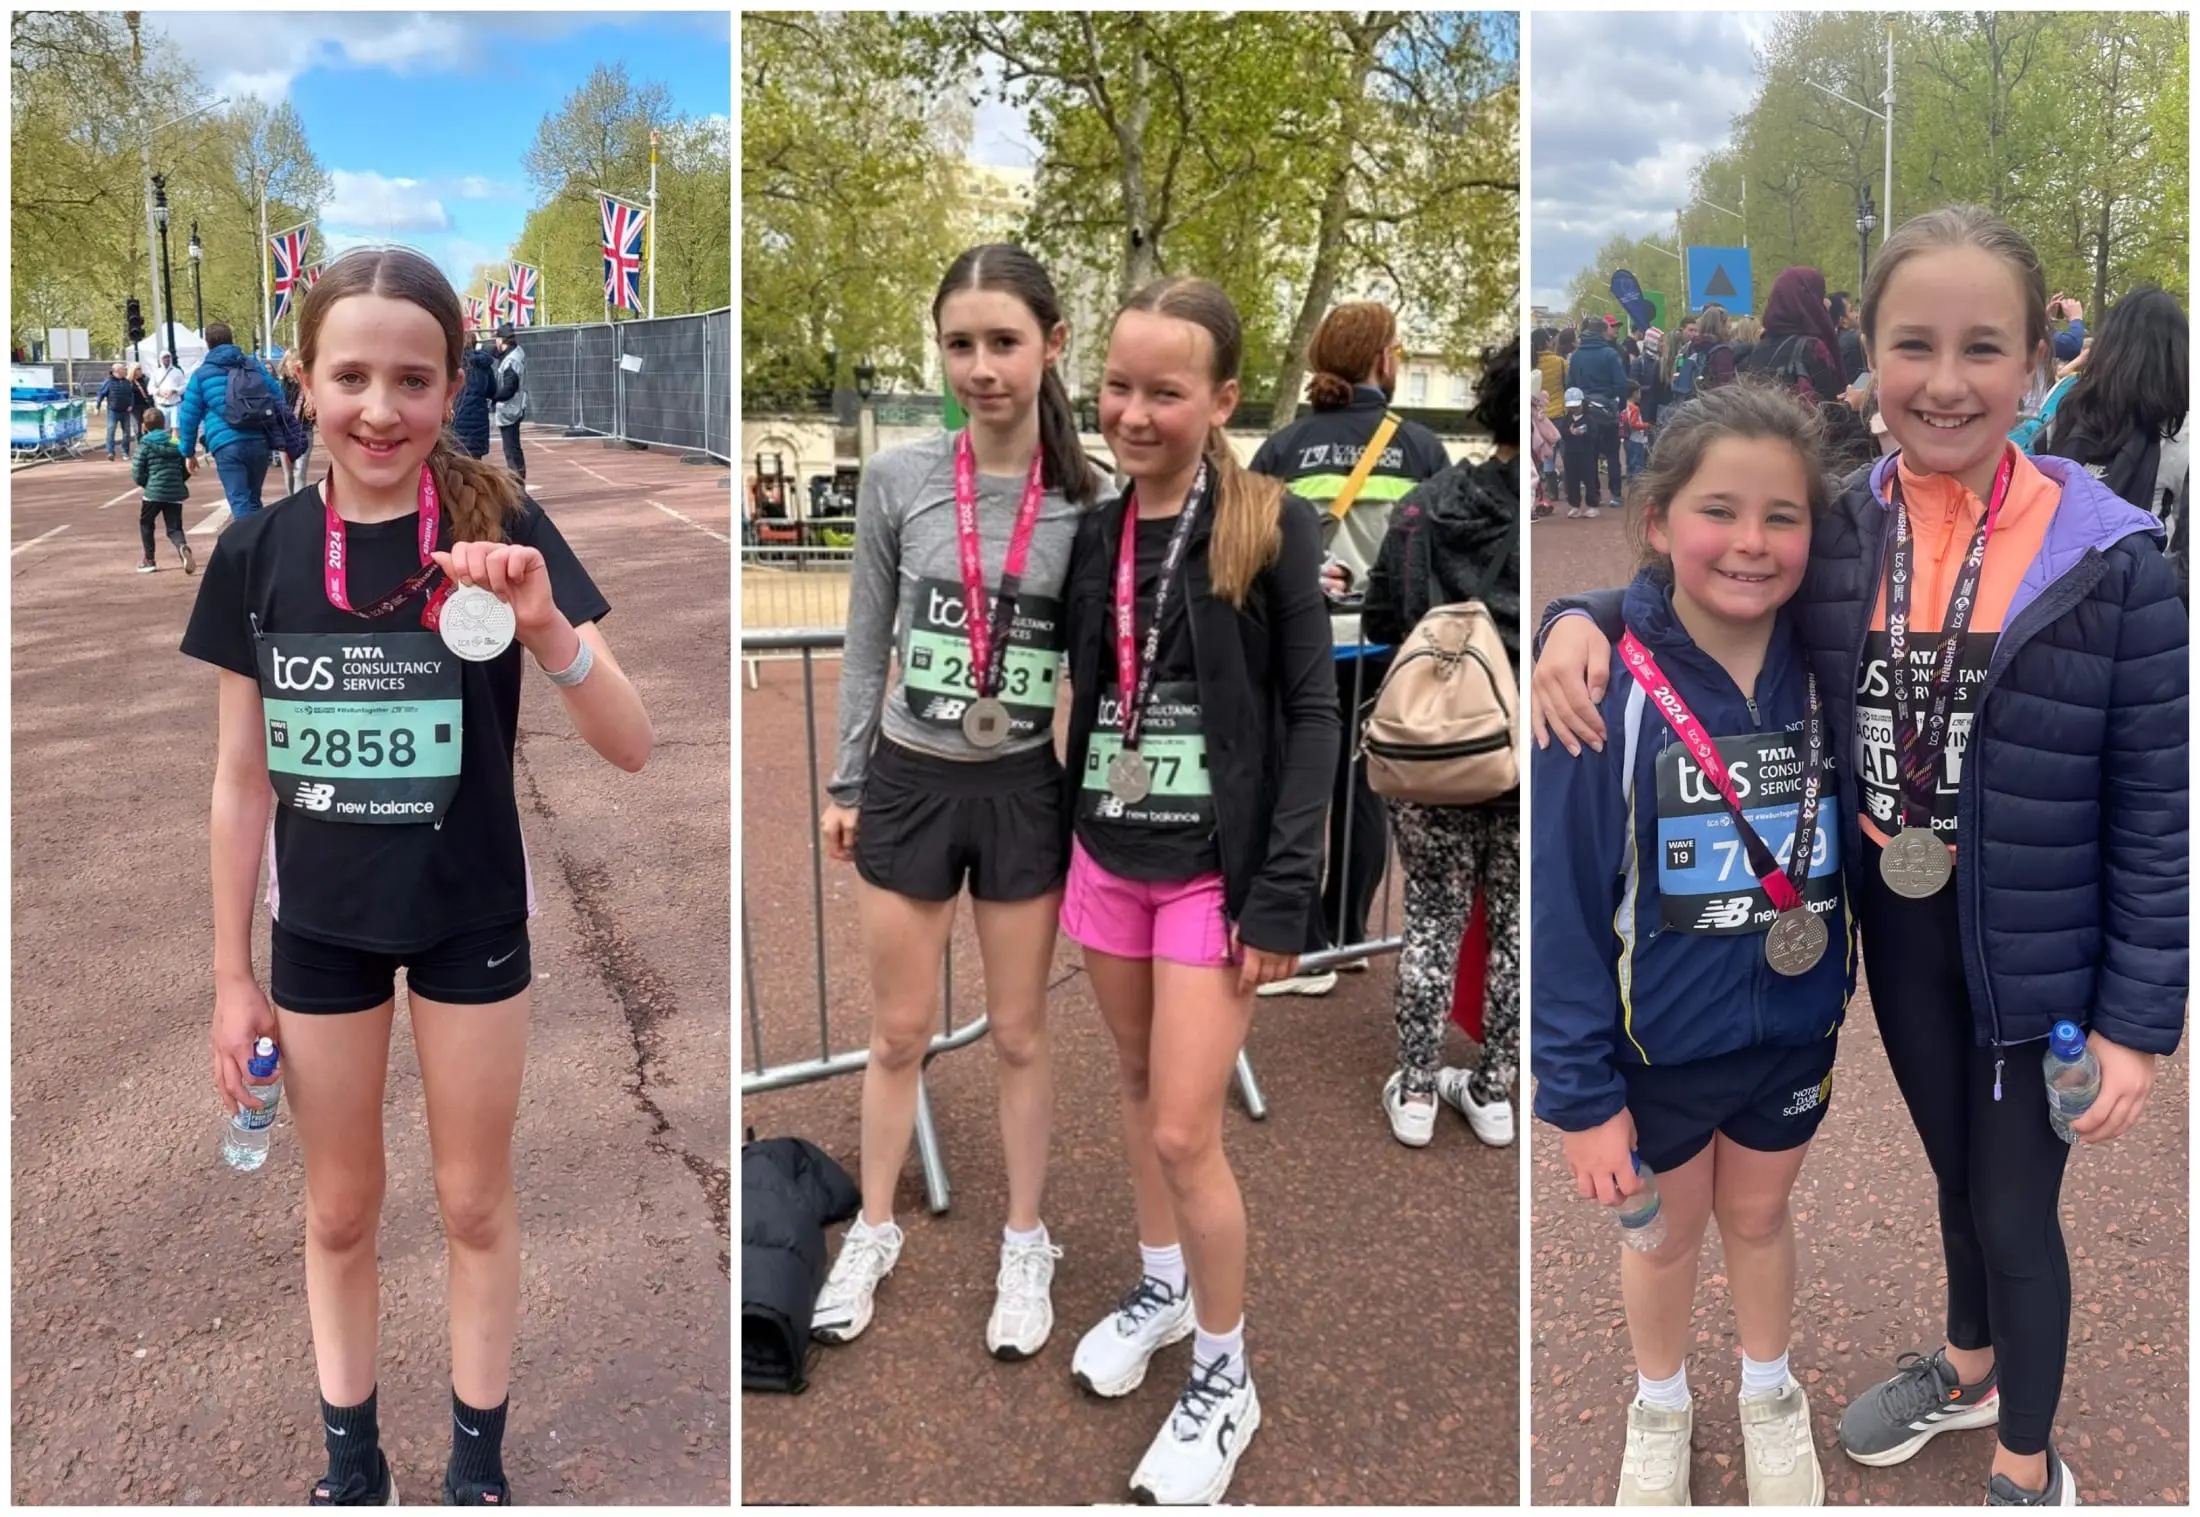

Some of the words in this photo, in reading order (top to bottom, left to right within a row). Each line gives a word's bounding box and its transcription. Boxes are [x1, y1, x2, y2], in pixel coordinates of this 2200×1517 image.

[1896, 502, 1907, 542] FINISHER
[328, 530, 342, 570] 2024
[1969, 525, 1987, 568] 202
[1895, 552, 1906, 568] tcs
[928, 587, 969, 630] tc
[1951, 611, 1964, 629] tcs
[1890, 613, 1905, 660] 2024
[342, 646, 384, 660] TATA
[1940, 639, 1957, 684] FINISHER
[272, 646, 335, 692] tcs
[342, 661, 442, 676] CONSULTANCY
[1894, 669, 1905, 685] tcs
[343, 677, 405, 692] SERVICES
[1653, 686, 1690, 725] 2024
[1811, 719, 1819, 734] tcs
[273, 730, 285, 743] 10
[1687, 728, 1702, 746] tcs
[1928, 730, 1940, 747] tcs
[300, 727, 417, 768] 2858
[1757, 746, 1796, 762] TATA
[1759, 756, 1836, 779] CONSUNC
[1678, 757, 1751, 804] tcs
[1760, 778, 1802, 796] SERVIC
[336, 801, 366, 815] new
[370, 799, 435, 815] balance
[1803, 777, 1818, 820] 2024
[1149, 810, 1201, 823] balance
[1668, 840, 1694, 849] WAVE
[1801, 828, 1811, 844] tcs
[1673, 851, 1689, 864] 19
[1783, 1099, 1819, 1117] SCHOOL
